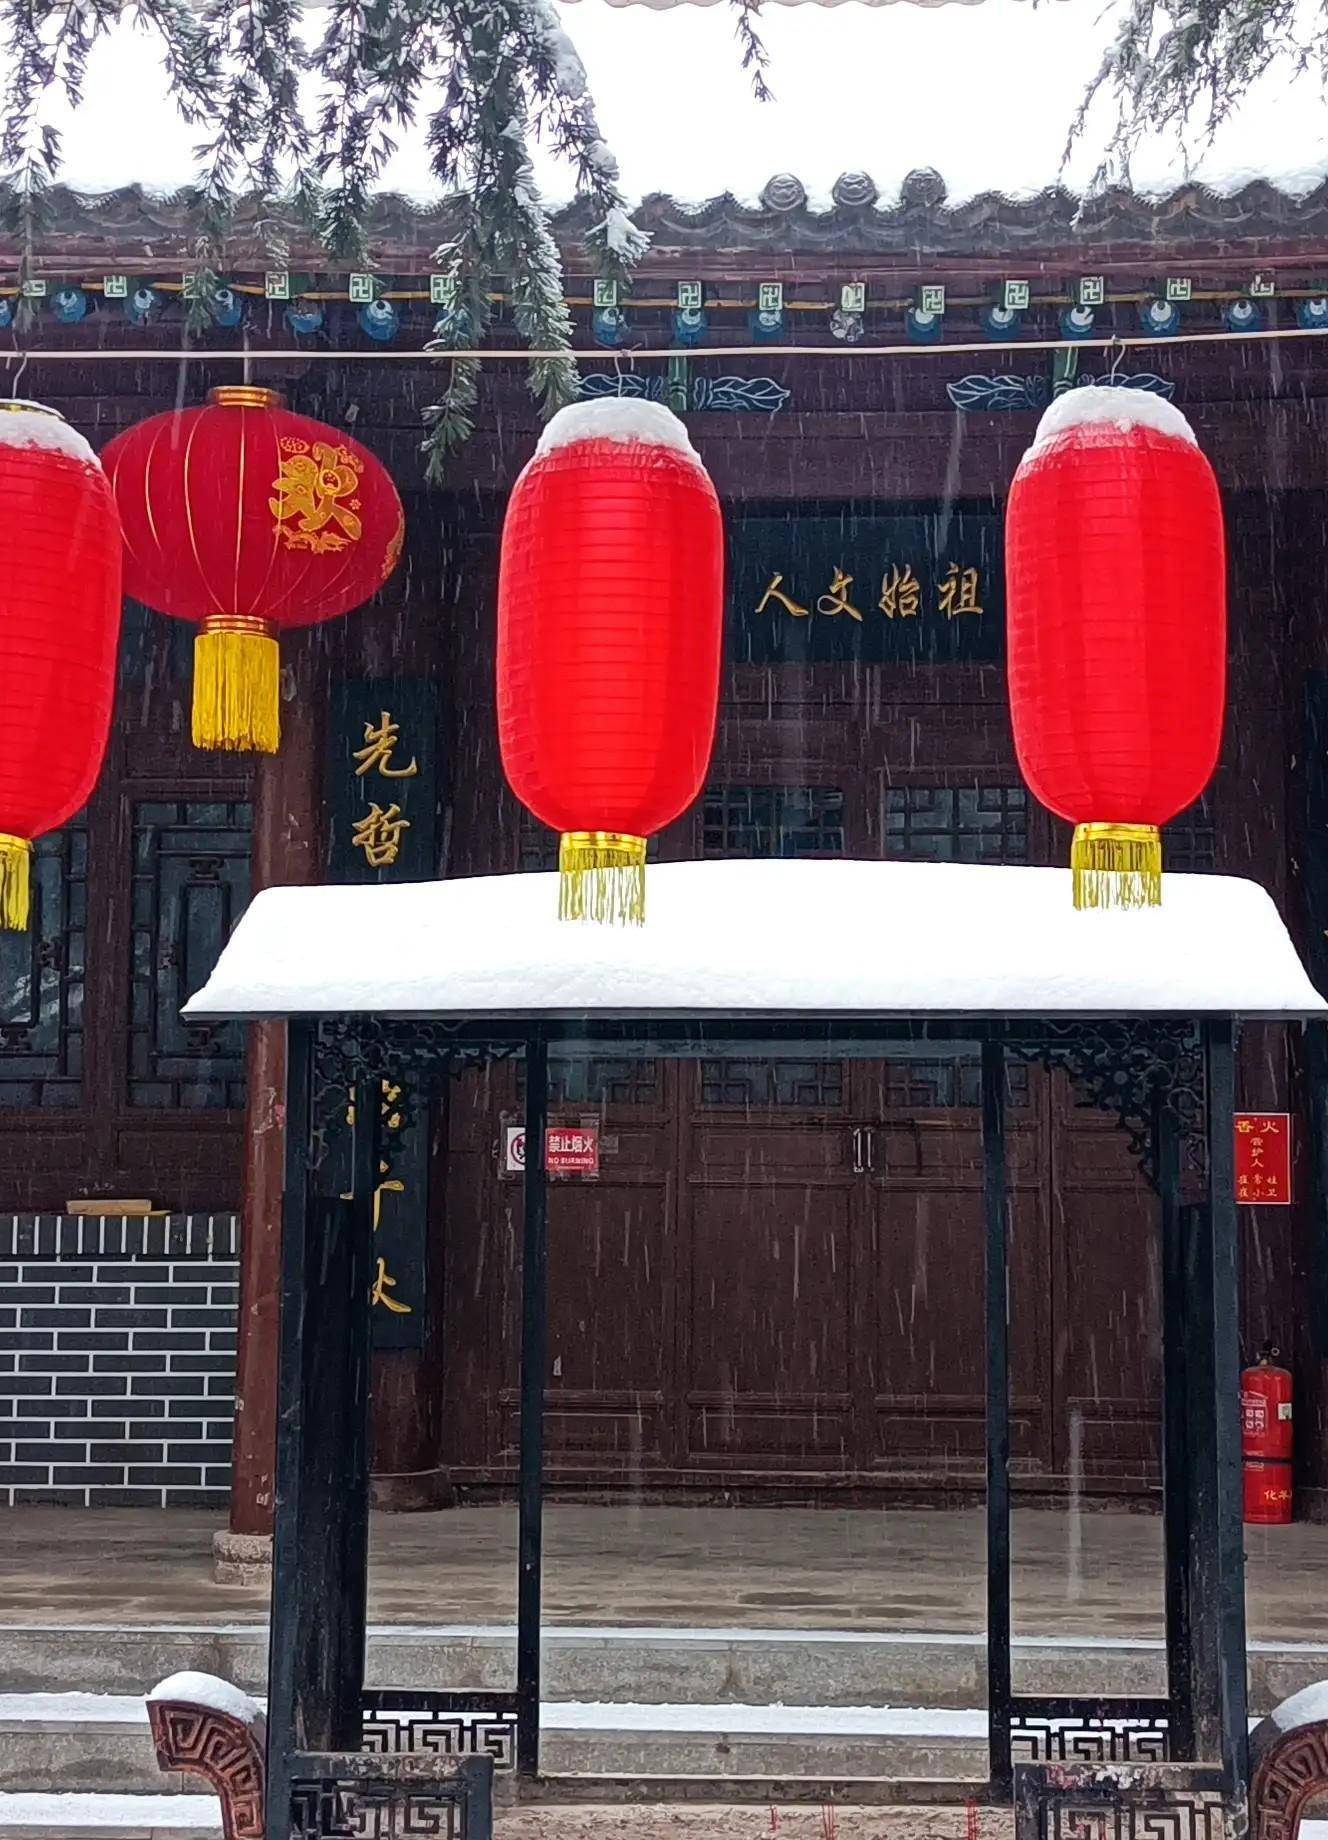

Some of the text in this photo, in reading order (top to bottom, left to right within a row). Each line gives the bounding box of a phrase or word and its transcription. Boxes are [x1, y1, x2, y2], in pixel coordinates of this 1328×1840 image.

[754, 561, 984, 622] 人文始祖
[548, 1135, 593, 1153] 禁止烟火
